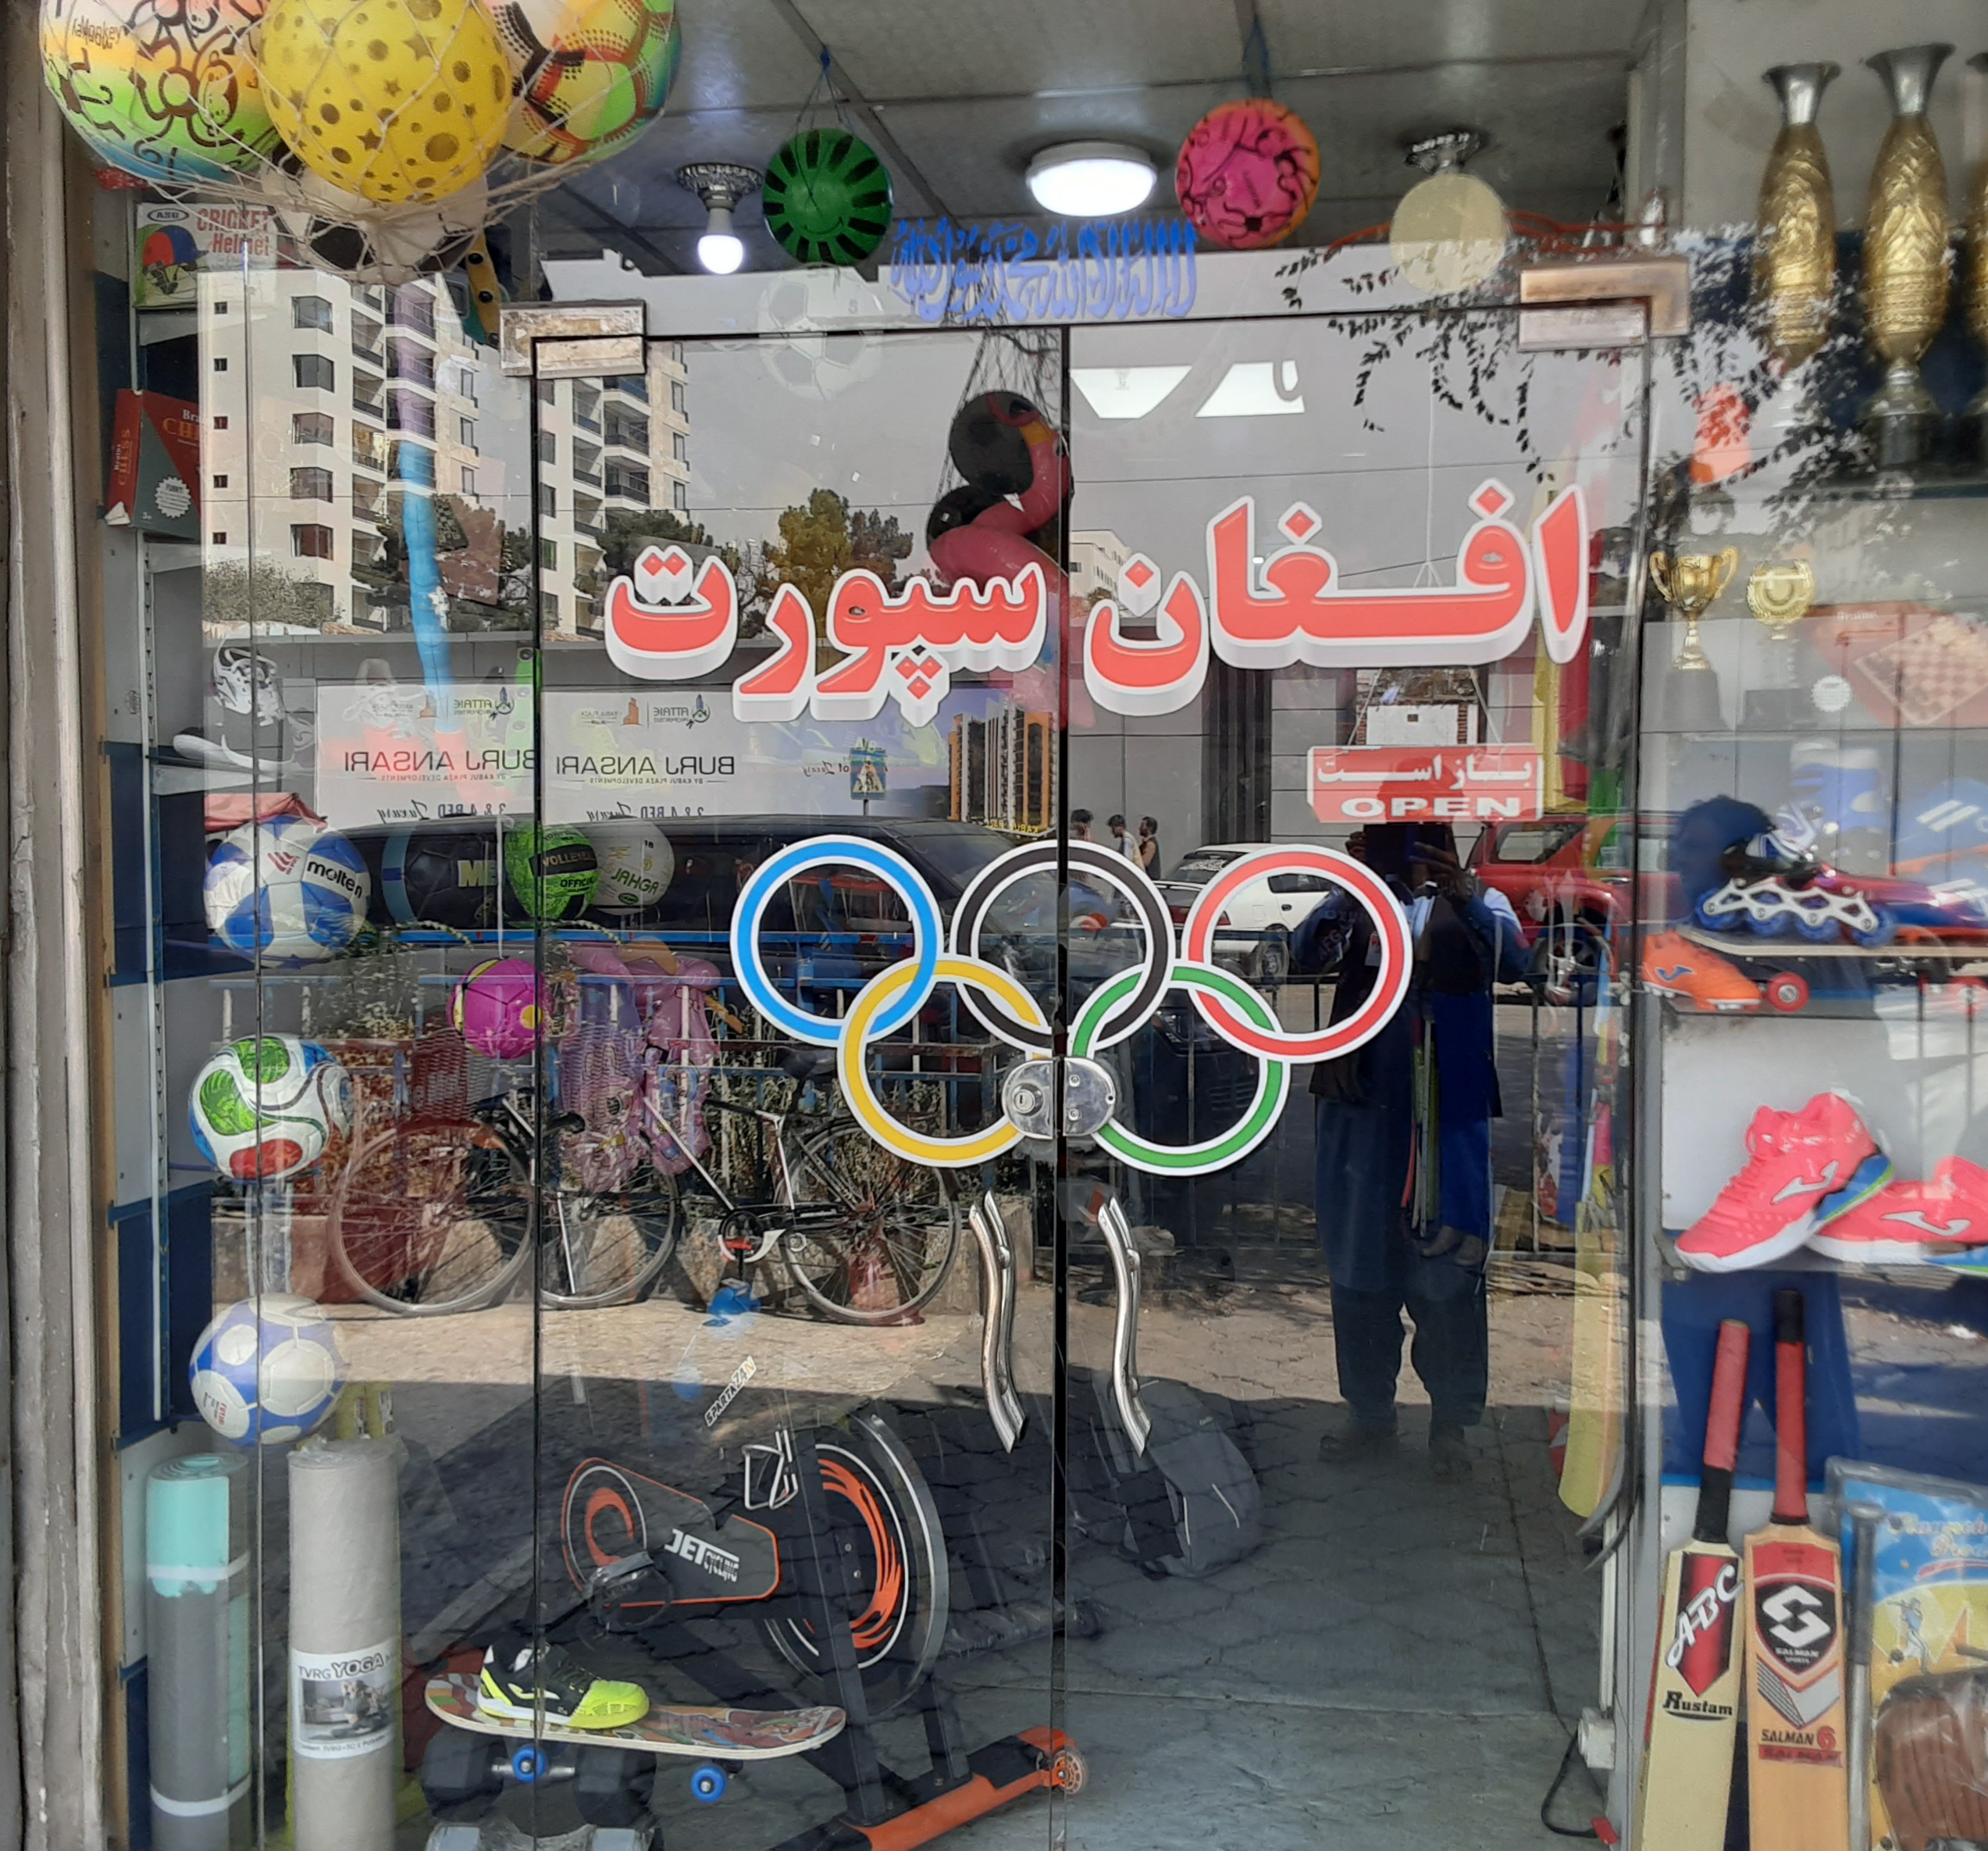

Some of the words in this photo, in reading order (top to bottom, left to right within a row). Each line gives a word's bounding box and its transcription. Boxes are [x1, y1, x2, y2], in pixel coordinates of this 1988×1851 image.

[196, 208, 270, 233] CRICKET
[212, 234, 269, 256] Helmet
[1084, 478, 1588, 716] افغان
[605, 545, 1047, 727] سپورت
[1317, 754, 1442, 783] است
[1449, 754, 1532, 790] باز
[1341, 797, 1521, 818] OPEN
[307, 861, 363, 899] molten
[1665, 1564, 1746, 1668] ABC
[331, 1652, 384, 1678] YOGA
[1662, 1690, 1733, 1717] Rustam
[1761, 1728, 1814, 1745] SALMAN
